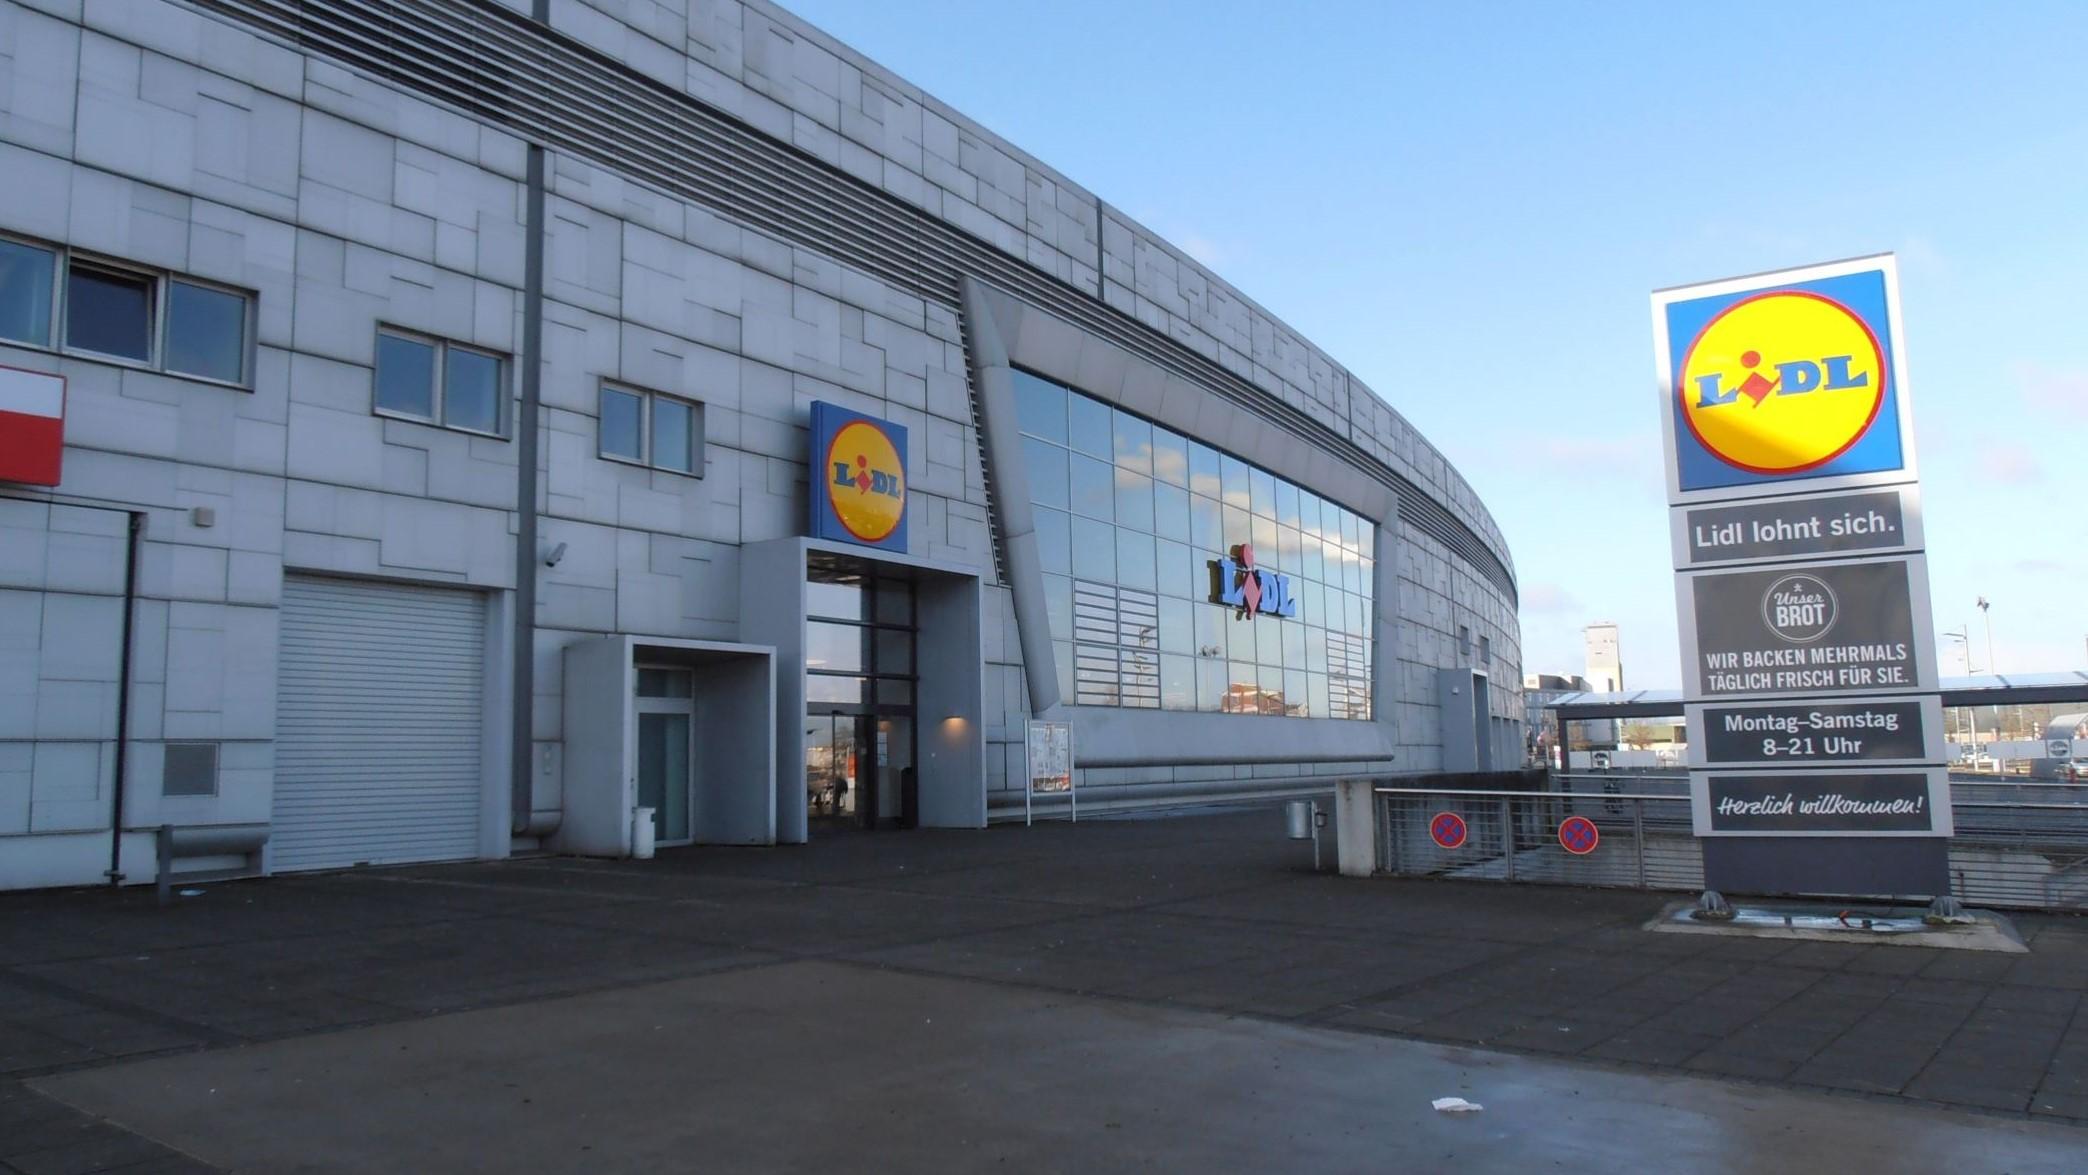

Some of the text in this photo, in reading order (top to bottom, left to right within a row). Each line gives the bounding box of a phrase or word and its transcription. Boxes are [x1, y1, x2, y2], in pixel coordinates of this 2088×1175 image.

[1696, 511, 1895, 547] Lidl lohnt sich.
[1773, 591, 1825, 605] Unser
[1776, 604, 1825, 627] BROT
[1706, 643, 1907, 669] WIR BACKEN MEHRMALS
[1708, 664, 1909, 691] TÄGLICH FRISCH FÜR SIE.
[1824, 737, 1862, 754] Uhr
[1717, 793, 1924, 815] Herzlich willkommen!
